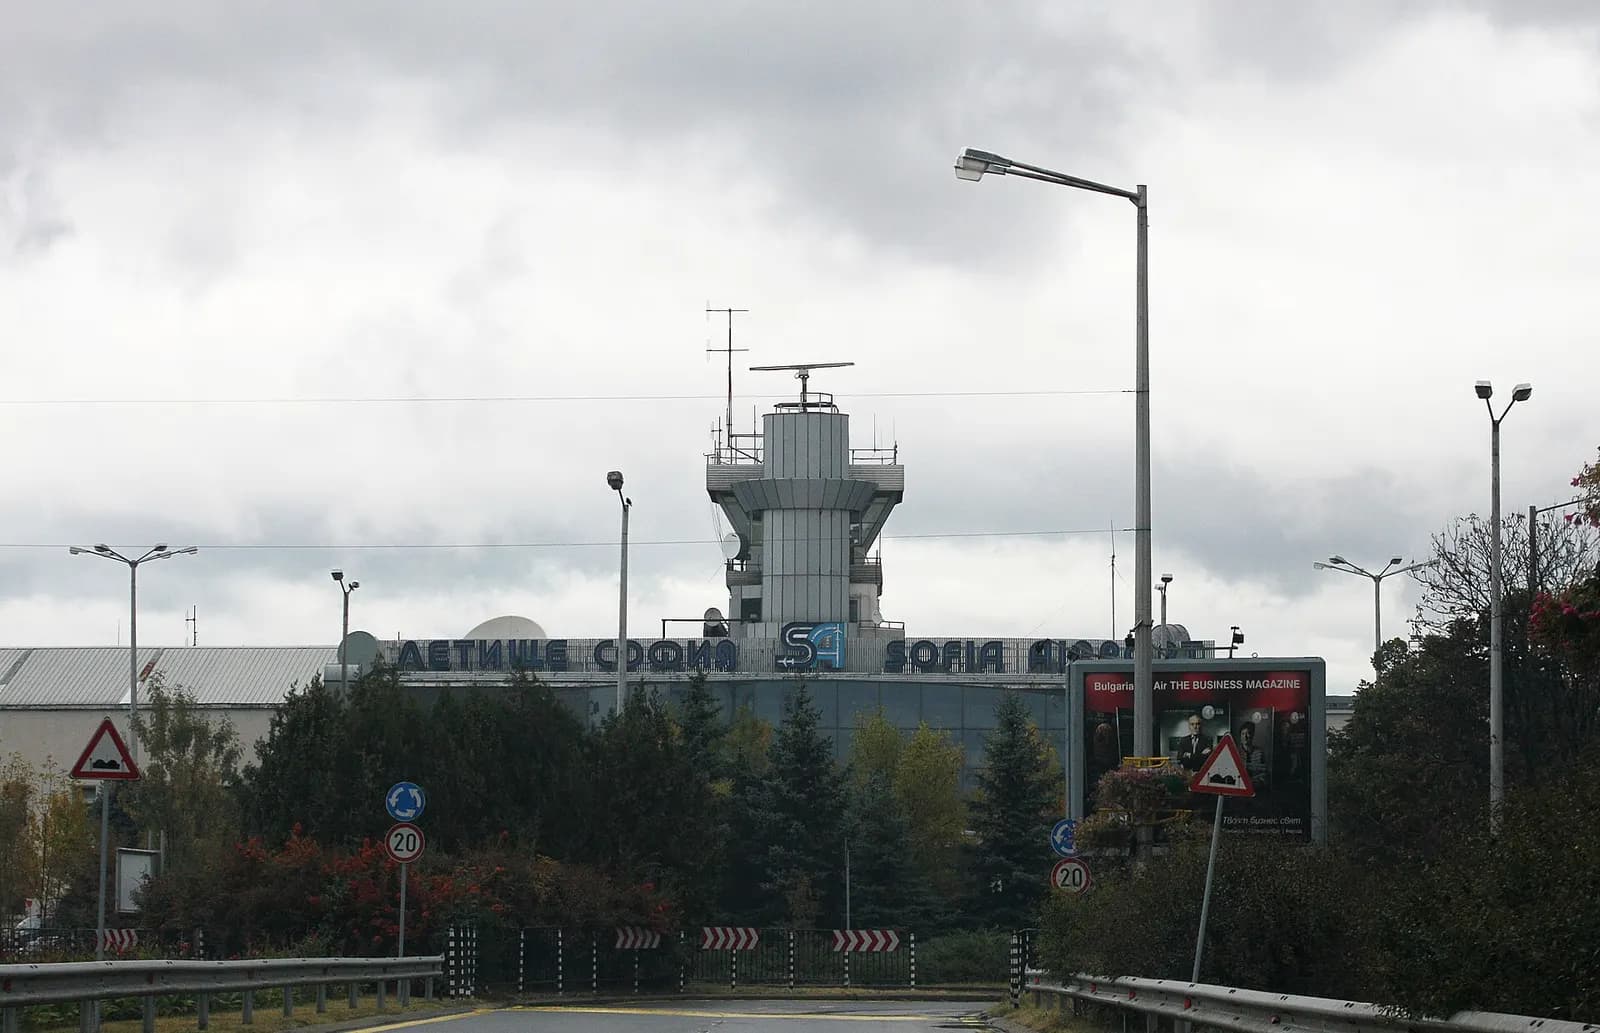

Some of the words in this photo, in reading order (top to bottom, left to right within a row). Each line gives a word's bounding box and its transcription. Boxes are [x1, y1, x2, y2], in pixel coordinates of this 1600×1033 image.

[593, 639, 737, 672] СОФИЯ
[886, 639, 1004, 673] SOFIA
[1094, 681, 1134, 693] Bulgaria
[1153, 680, 1168, 690] Air
[1170, 680, 1190, 690] THE
[1192, 679, 1243, 690] BUSINESS
[1246, 679, 1301, 689] MAGAZINE
[394, 832, 417, 852] 20
[1060, 867, 1083, 887] 20
